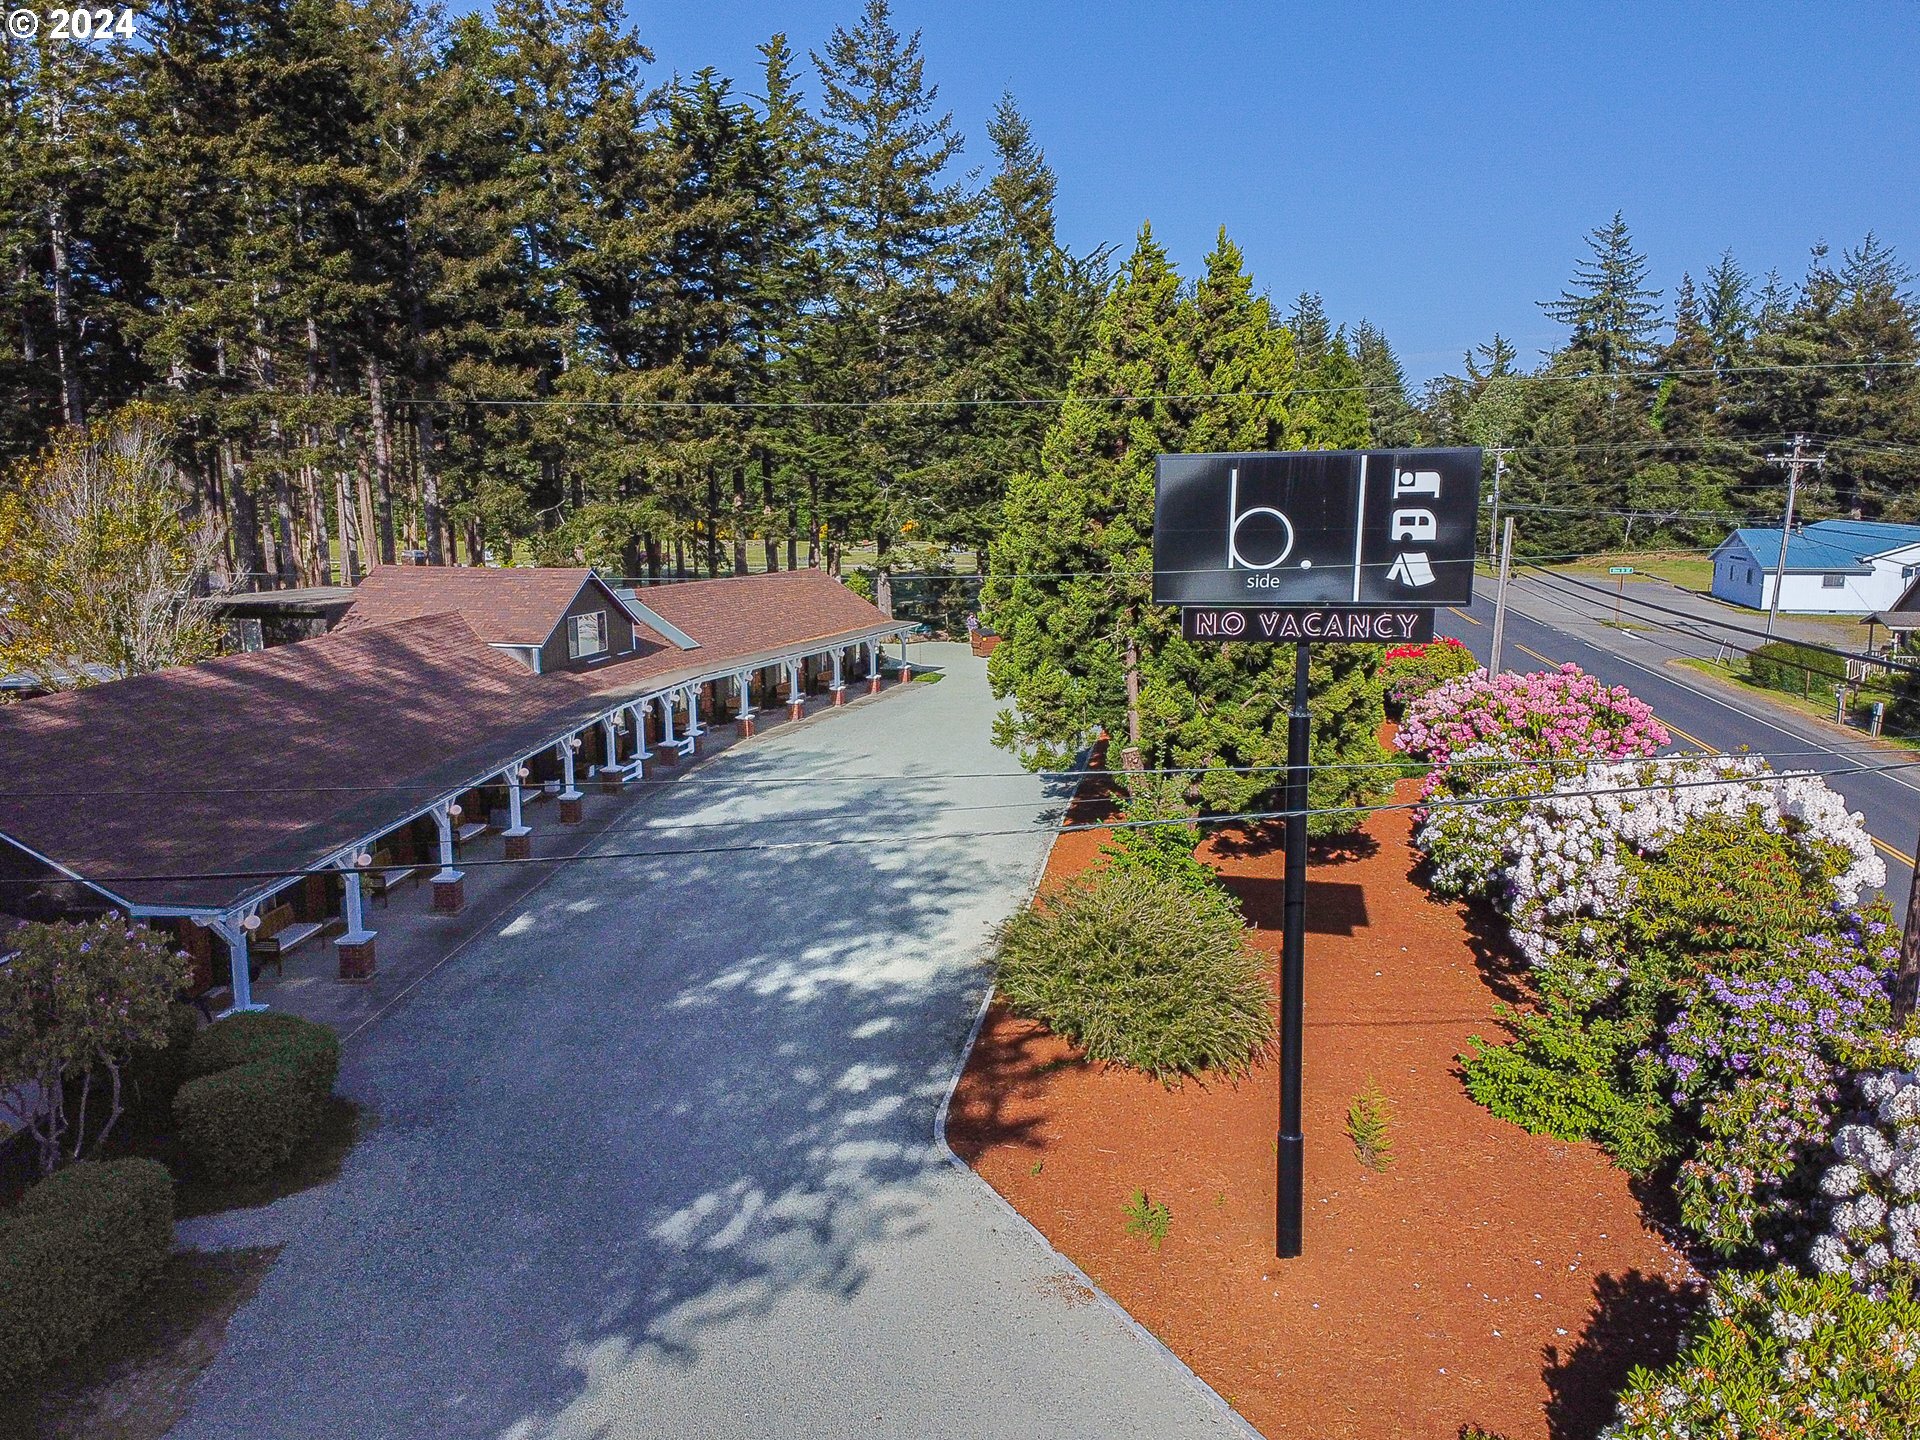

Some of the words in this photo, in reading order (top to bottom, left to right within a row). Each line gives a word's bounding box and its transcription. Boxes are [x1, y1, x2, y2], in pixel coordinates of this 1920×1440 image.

[1246, 573, 1280, 588] side
[1196, 611, 1246, 636] NO
[1259, 612, 1419, 639] VACANCY
